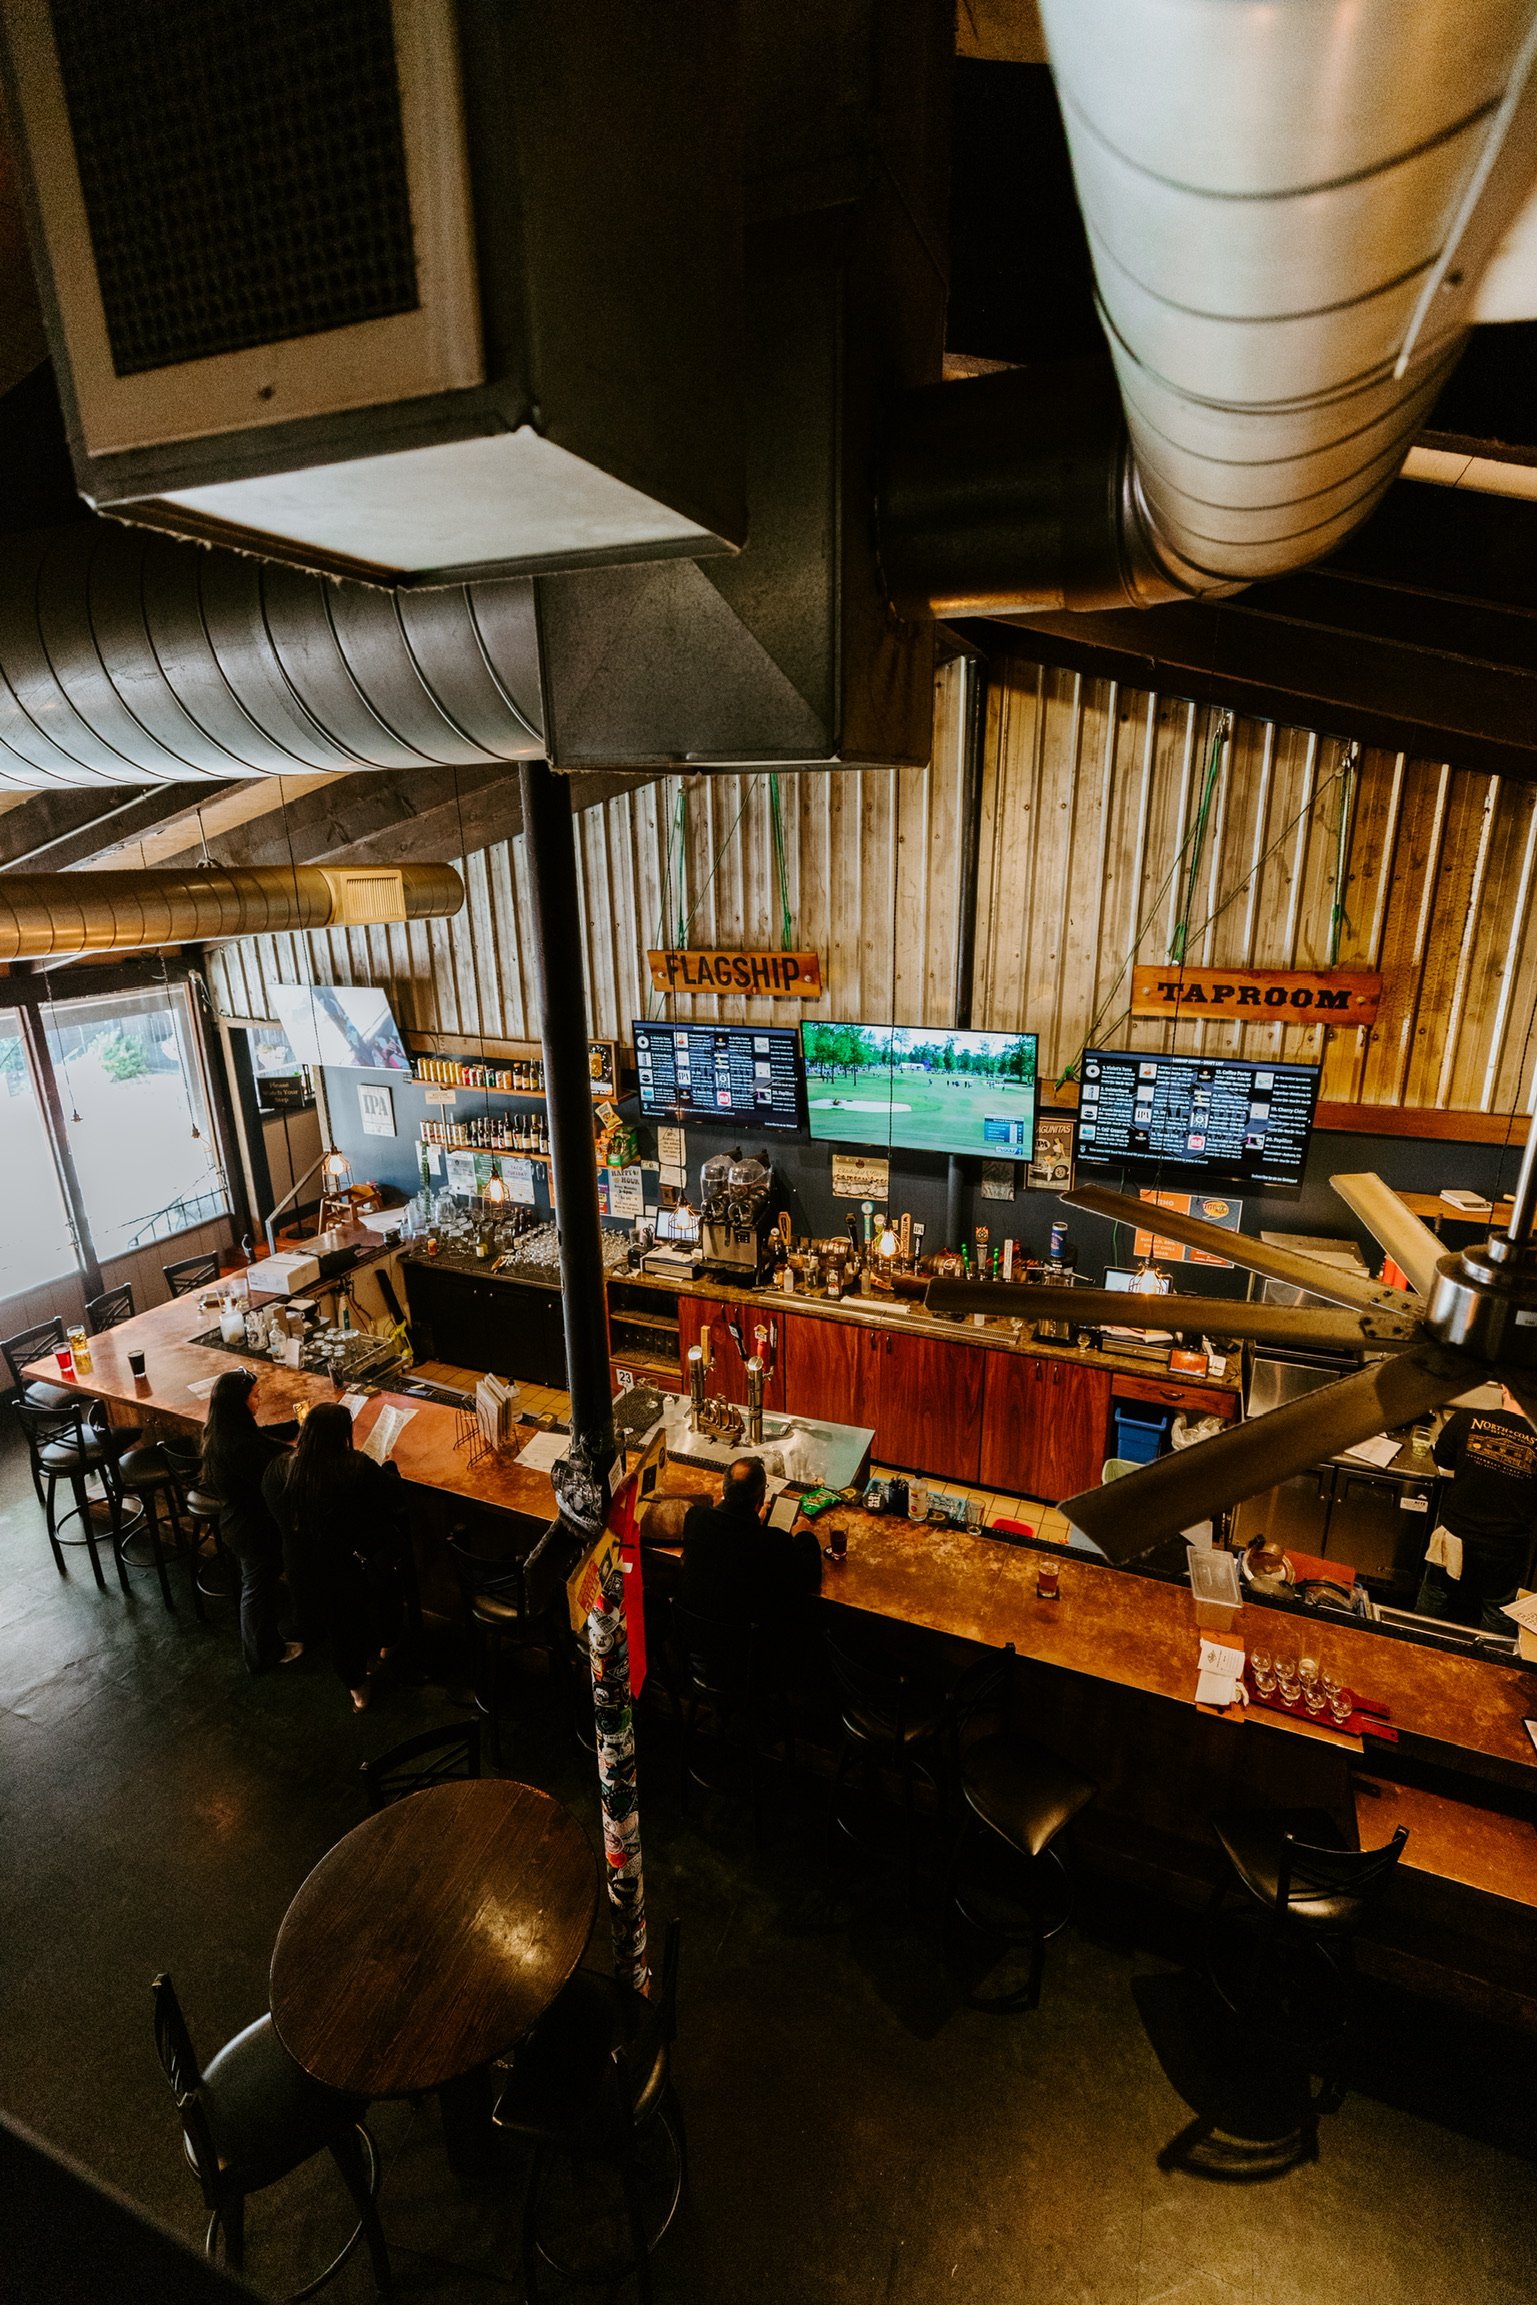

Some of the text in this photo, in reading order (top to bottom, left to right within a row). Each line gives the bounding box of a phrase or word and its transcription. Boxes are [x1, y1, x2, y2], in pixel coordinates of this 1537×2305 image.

[665, 953, 801, 991] FLAGSHIP
[1157, 981, 1353, 1010] TAPROOM
[362, 1094, 388, 1116] IPA
[1035, 1125, 1071, 1134] AGUNITAS
[619, 1371, 632, 1384] 23
[1470, 1418, 1508, 1434] NORTH
